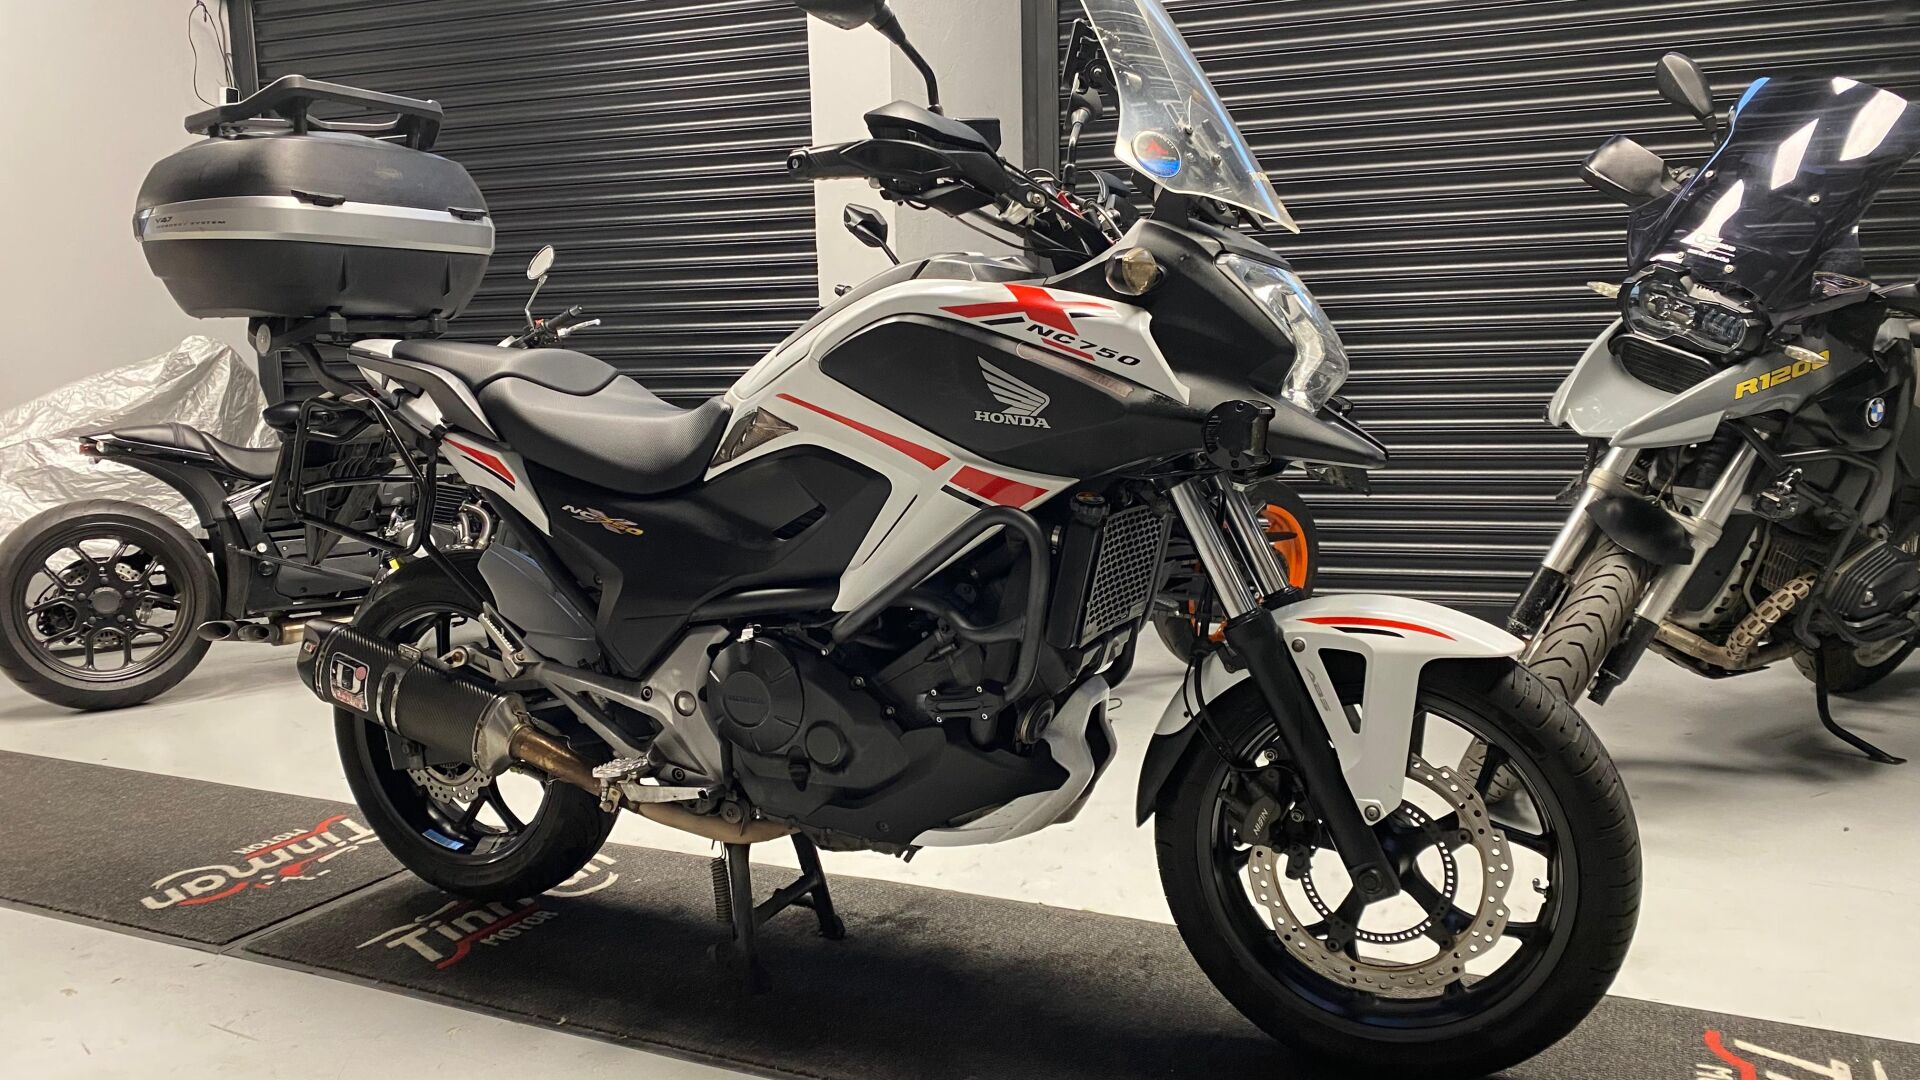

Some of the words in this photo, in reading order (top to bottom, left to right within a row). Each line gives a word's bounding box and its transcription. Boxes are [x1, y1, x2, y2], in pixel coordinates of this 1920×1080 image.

[1026, 323, 1141, 366] NC750
[974, 410, 1051, 429] HONDA
[1304, 666, 1331, 711] ABS
[232, 828, 309, 855] MOTOR
[480, 910, 560, 947] MOTOR
